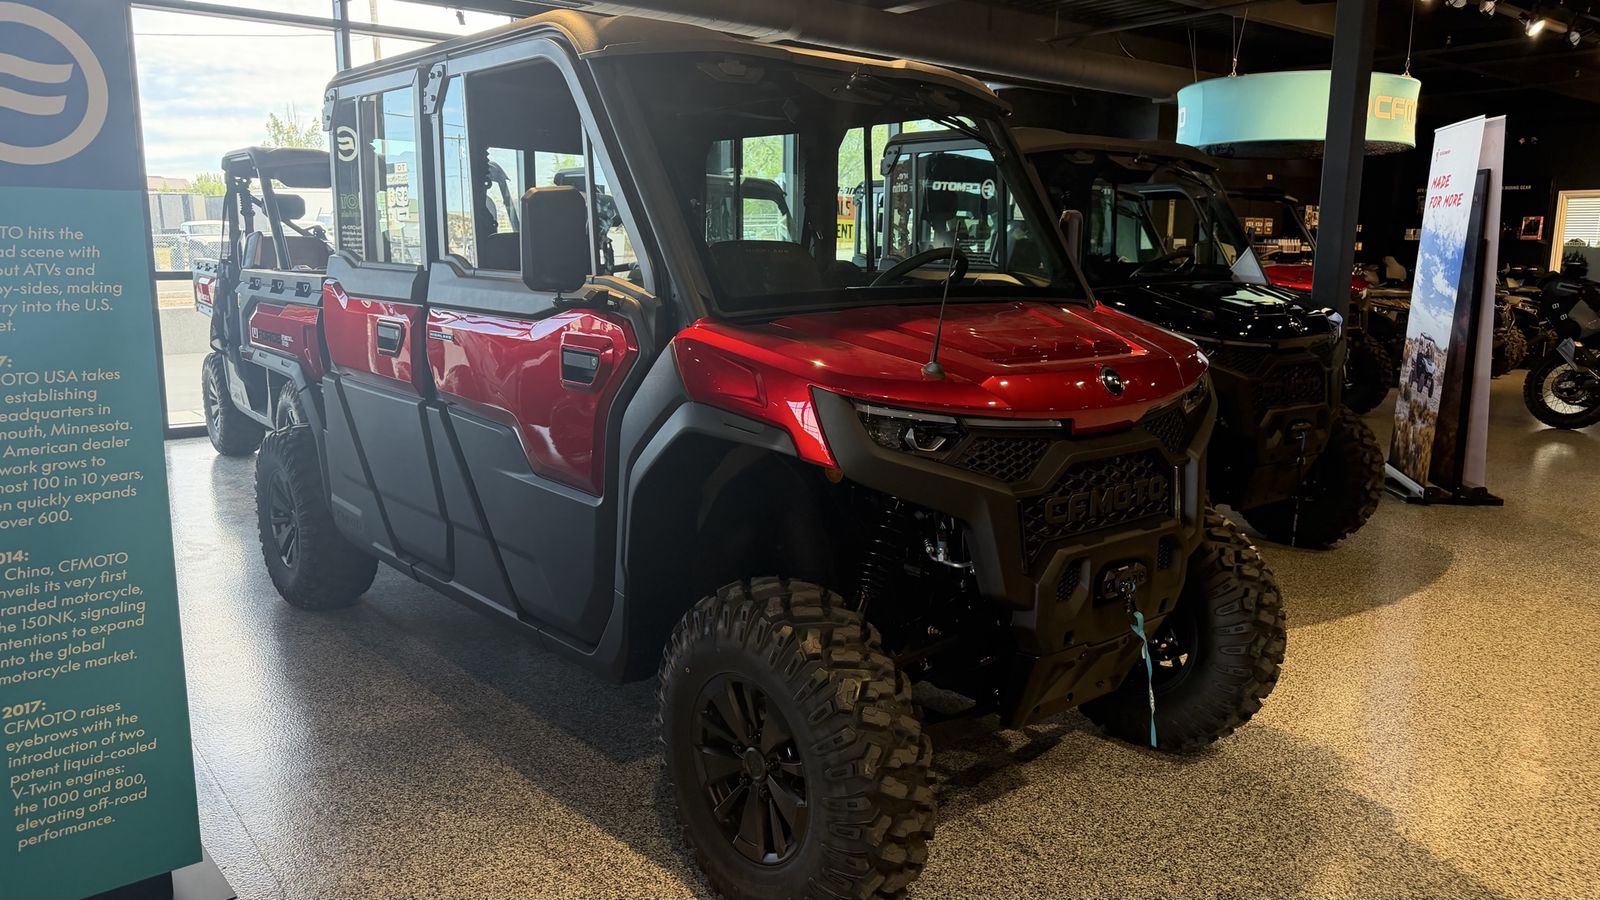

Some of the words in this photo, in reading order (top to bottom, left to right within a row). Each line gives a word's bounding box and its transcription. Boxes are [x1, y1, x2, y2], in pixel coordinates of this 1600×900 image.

[1431, 174, 1452, 189] MADE
[1428, 196, 1443, 208] FOR
[1443, 192, 1464, 208] MORE
[28, 226, 54, 239] hits
[59, 227, 83, 239] the
[21, 248, 64, 257] scene
[69, 246, 100, 257] with
[23, 264, 61, 276] ATVs
[66, 264, 95, 275] and
[67, 281, 122, 296] making
[22, 301, 51, 312] into
[56, 299, 81, 312] the
[85, 299, 112, 311] U.S.
[44, 370, 78, 383] USA
[81, 368, 120, 381] takes
[5, 387, 97, 403] establishing
[98, 404, 110, 415] in
[50, 420, 133, 436] Minnesota.
[2, 443, 77, 458] American
[82, 436, 130, 450] dealer
[41, 457, 86, 475] grows
[91, 456, 106, 467] to
[32, 476, 59, 490] 100
[64, 476, 77, 486] in
[82, 473, 97, 485] 10
[101, 470, 143, 486] years,
[17, 493, 71, 512] quickly
[74, 485, 136, 504] expands
[1044, 473, 1166, 524] CFMOTO
[0, 516, 34, 529] over
[38, 510, 72, 524] 600.
[5, 566, 54, 580] China,
[58, 552, 128, 572] CFMOTO
[44, 581, 60, 592] its
[64, 576, 96, 588] very
[100, 570, 127, 583] first
[62, 584, 143, 606] motorcycle,
[22, 610, 76, 630] 150NK,
[80, 601, 145, 621] signaling
[72, 627, 86, 637] to
[90, 615, 144, 634] expand
[30, 650, 53, 662] the
[58, 638, 105, 660] global
[0, 660, 80, 684] motorcycle
[85, 650, 137, 668] market.
[1, 700, 46, 719] 2017:
[4, 709, 76, 735] CFMOTO
[80, 703, 121, 718] raises
[6, 728, 78, 753] eyebrows
[82, 719, 112, 734] with
[116, 714, 138, 726] the
[8, 740, 97, 768] introduction
[102, 732, 116, 745] of
[119, 729, 145, 741] two
[10, 764, 59, 788] potent
[64, 738, 157, 771] liquid-cooled
[12, 780, 62, 799] V-Twin
[66, 764, 125, 784] engines:
[14, 802, 38, 816] the
[43, 790, 79, 808] 1000
[83, 781, 111, 798] and
[115, 773, 146, 789] 800,
[16, 807, 85, 832] elevating
[89, 786, 147, 812] off-road
[18, 815, 115, 852] performance.
